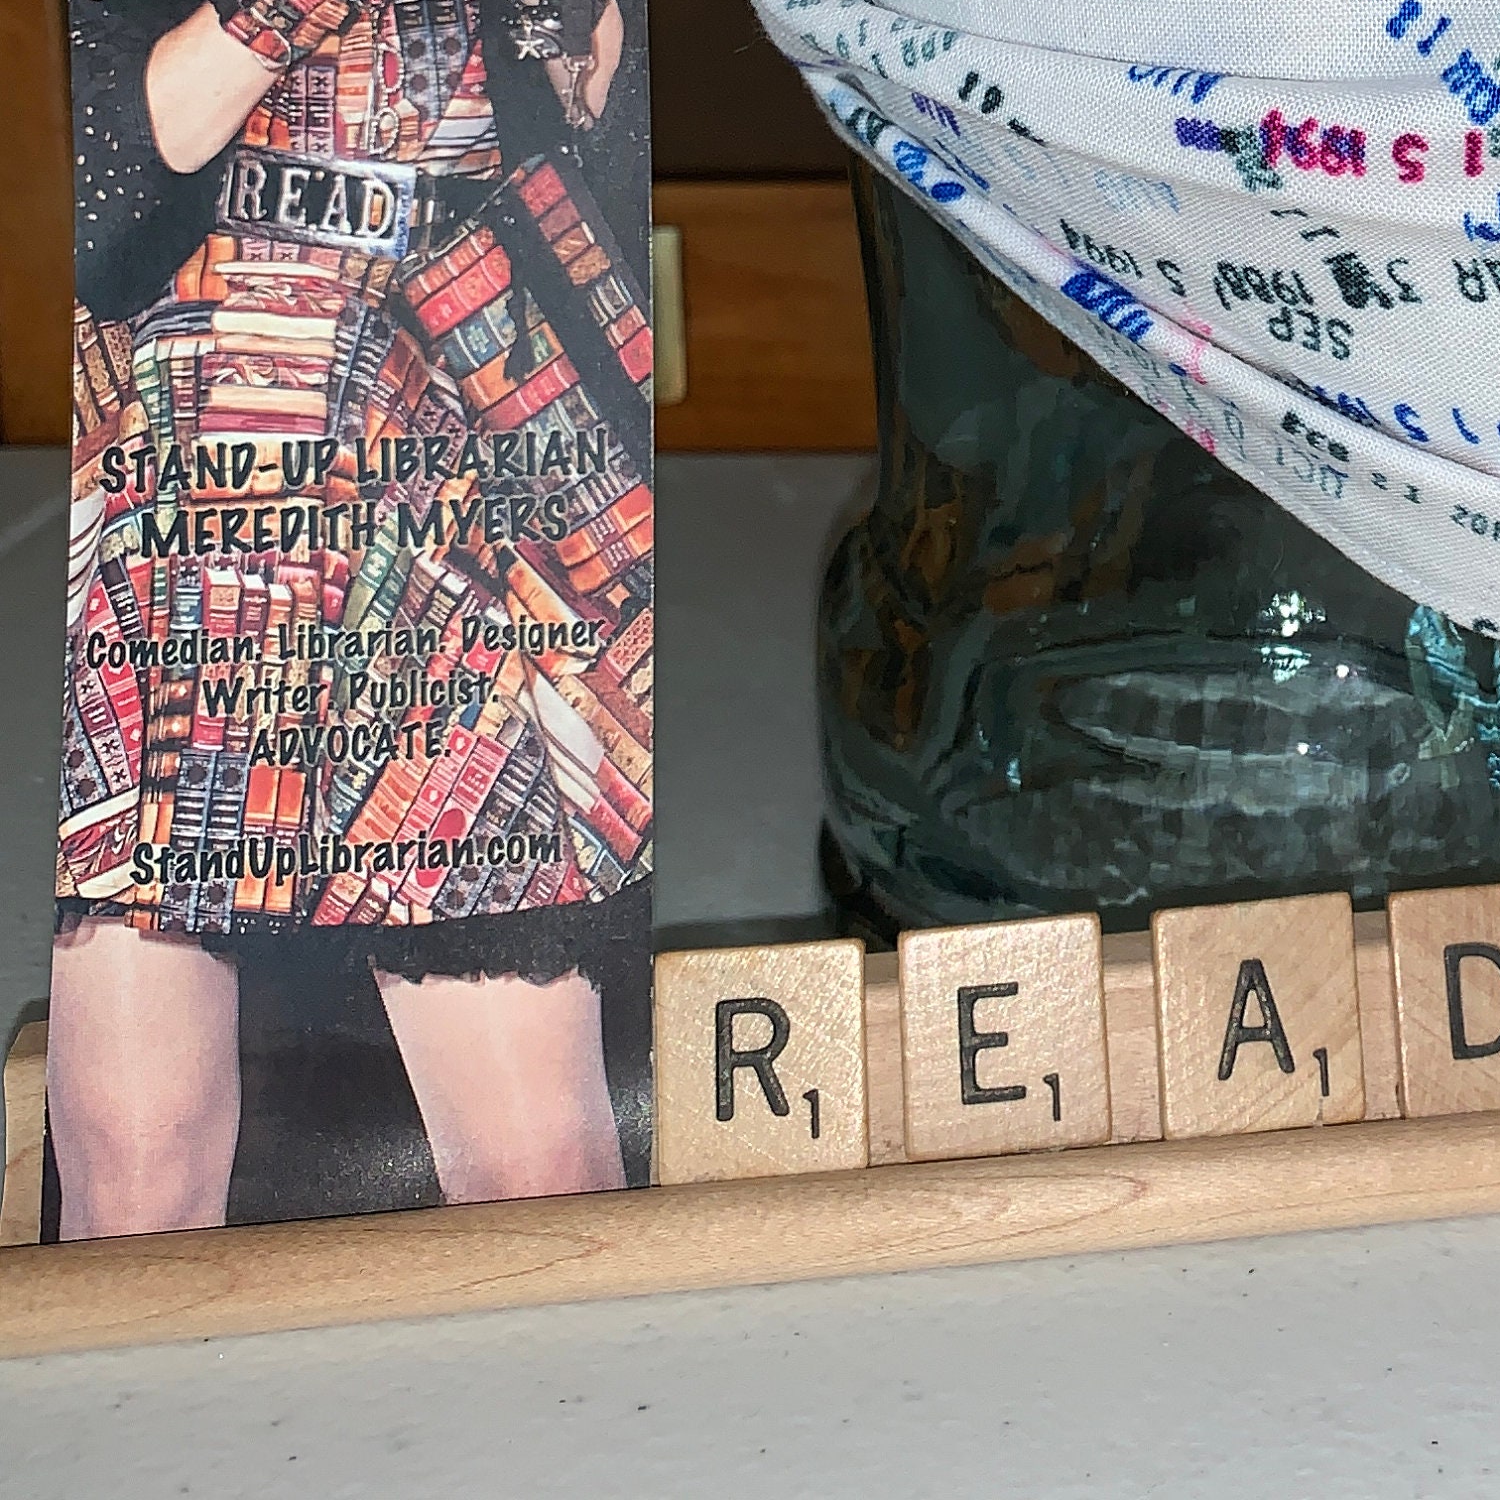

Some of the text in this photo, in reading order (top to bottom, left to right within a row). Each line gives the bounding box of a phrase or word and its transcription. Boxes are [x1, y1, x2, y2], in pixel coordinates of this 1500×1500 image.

[229, 157, 396, 240] READ
[1267, 309, 1354, 361] SEP
[101, 429, 608, 494] STAND-UP LIBRARIAN
[140, 498, 571, 560] MEREDITH MYERS
[86, 629, 262, 669] Comedian.
[277, 623, 445, 662] Librarian.
[346, 668, 499, 710] Publicist.
[130, 834, 565, 887] StandUpLibrarian.com
